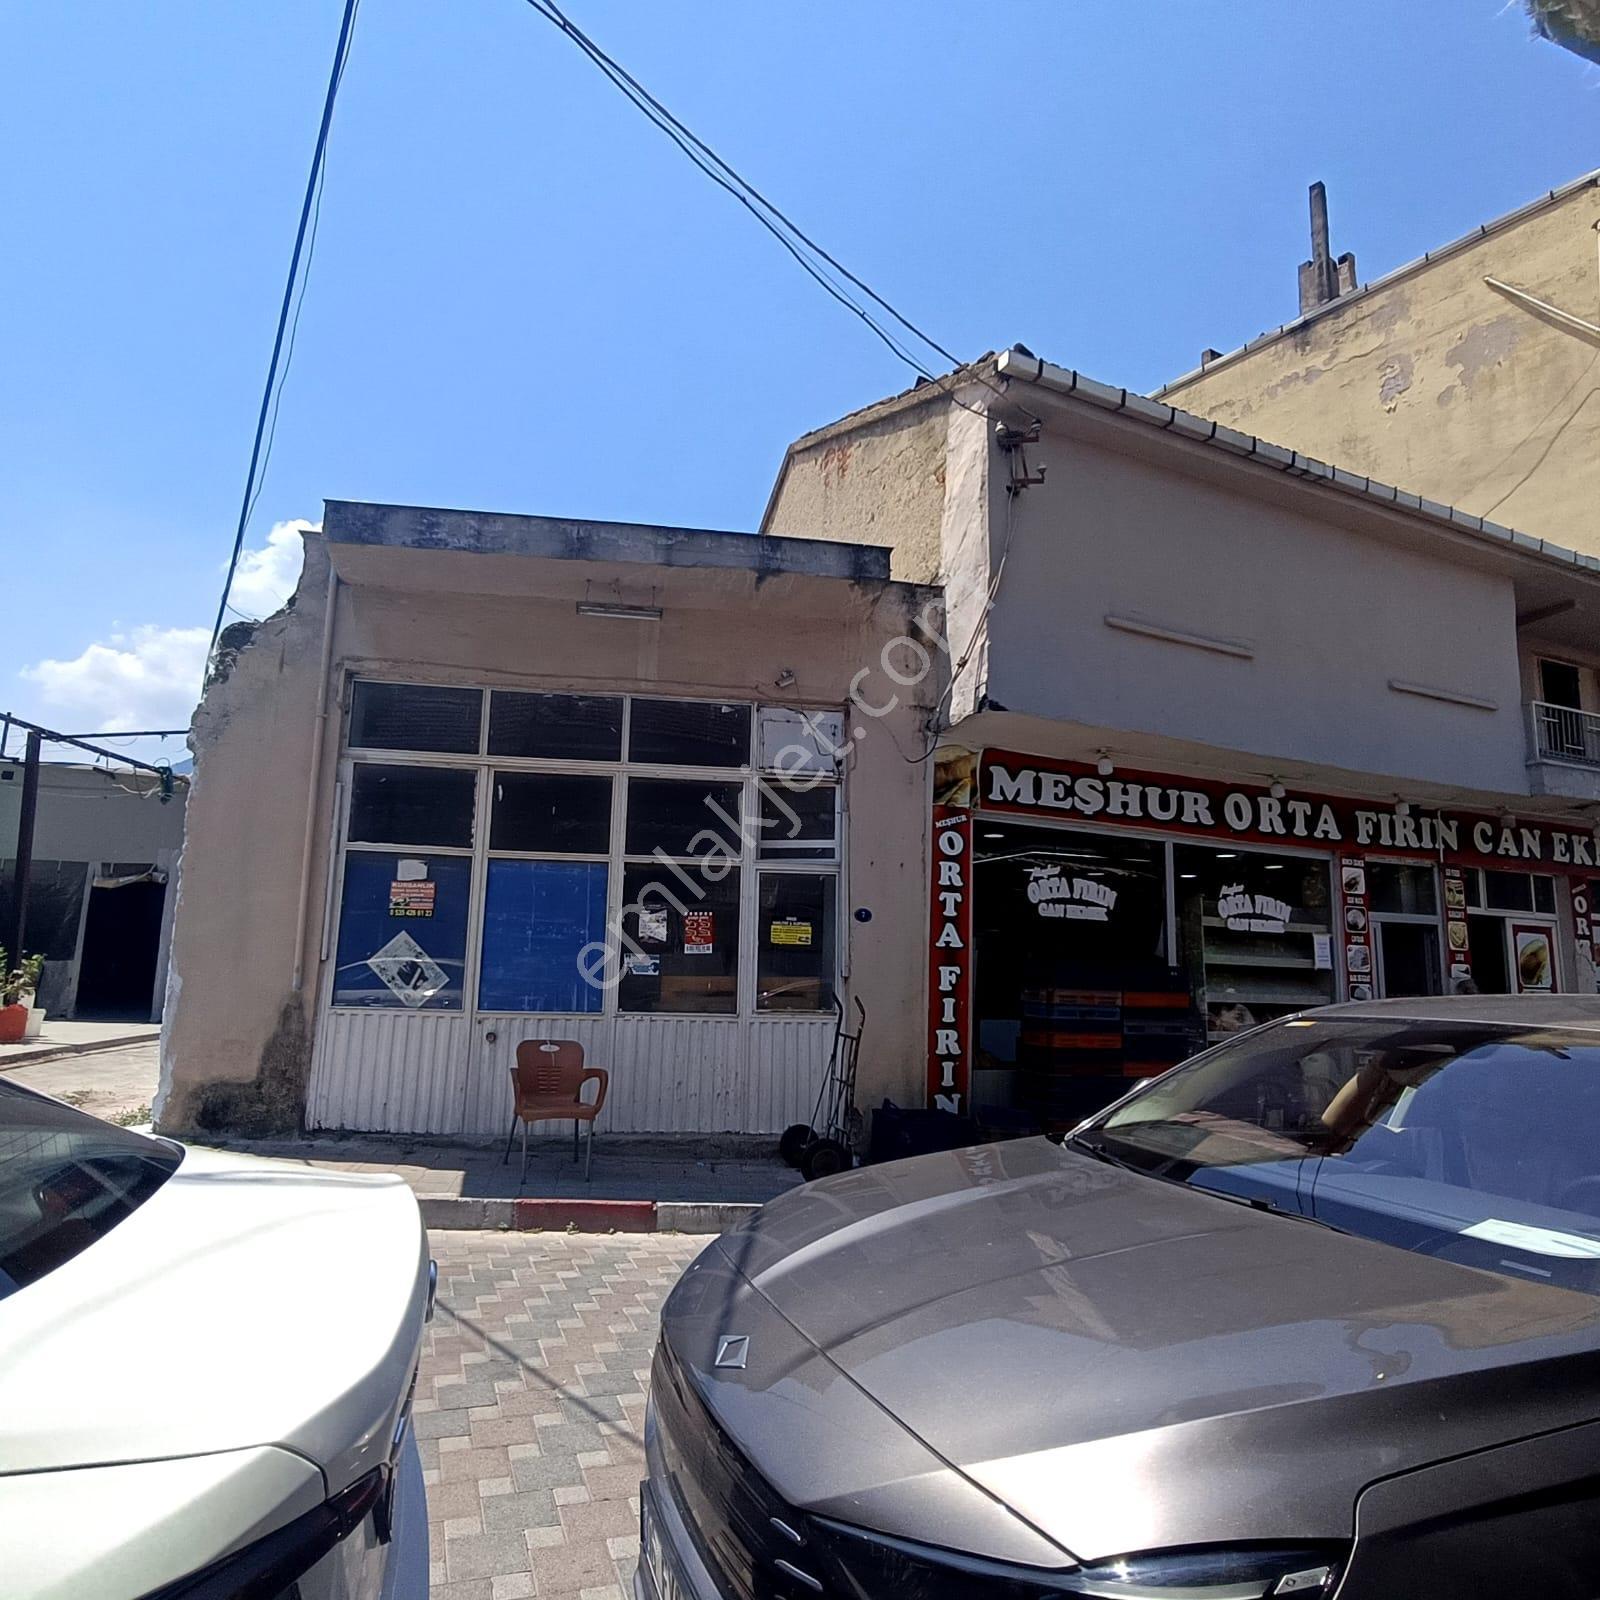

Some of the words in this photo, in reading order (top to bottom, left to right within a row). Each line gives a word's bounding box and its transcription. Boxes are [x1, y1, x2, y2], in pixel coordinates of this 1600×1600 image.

[935, 814, 968, 829] MEŞHUR
[988, 765, 1215, 825] MEŞHUR
[1224, 792, 1341, 840] ORTA
[1355, 810, 1459, 850] FIRIN
[1473, 821, 1542, 859] CAN
[935, 830, 964, 948] ORTA
[1027, 876, 1071, 904] ORTA
[1217, 893, 1254, 919] ORTA
[934, 966, 962, 1114] FIRIN
